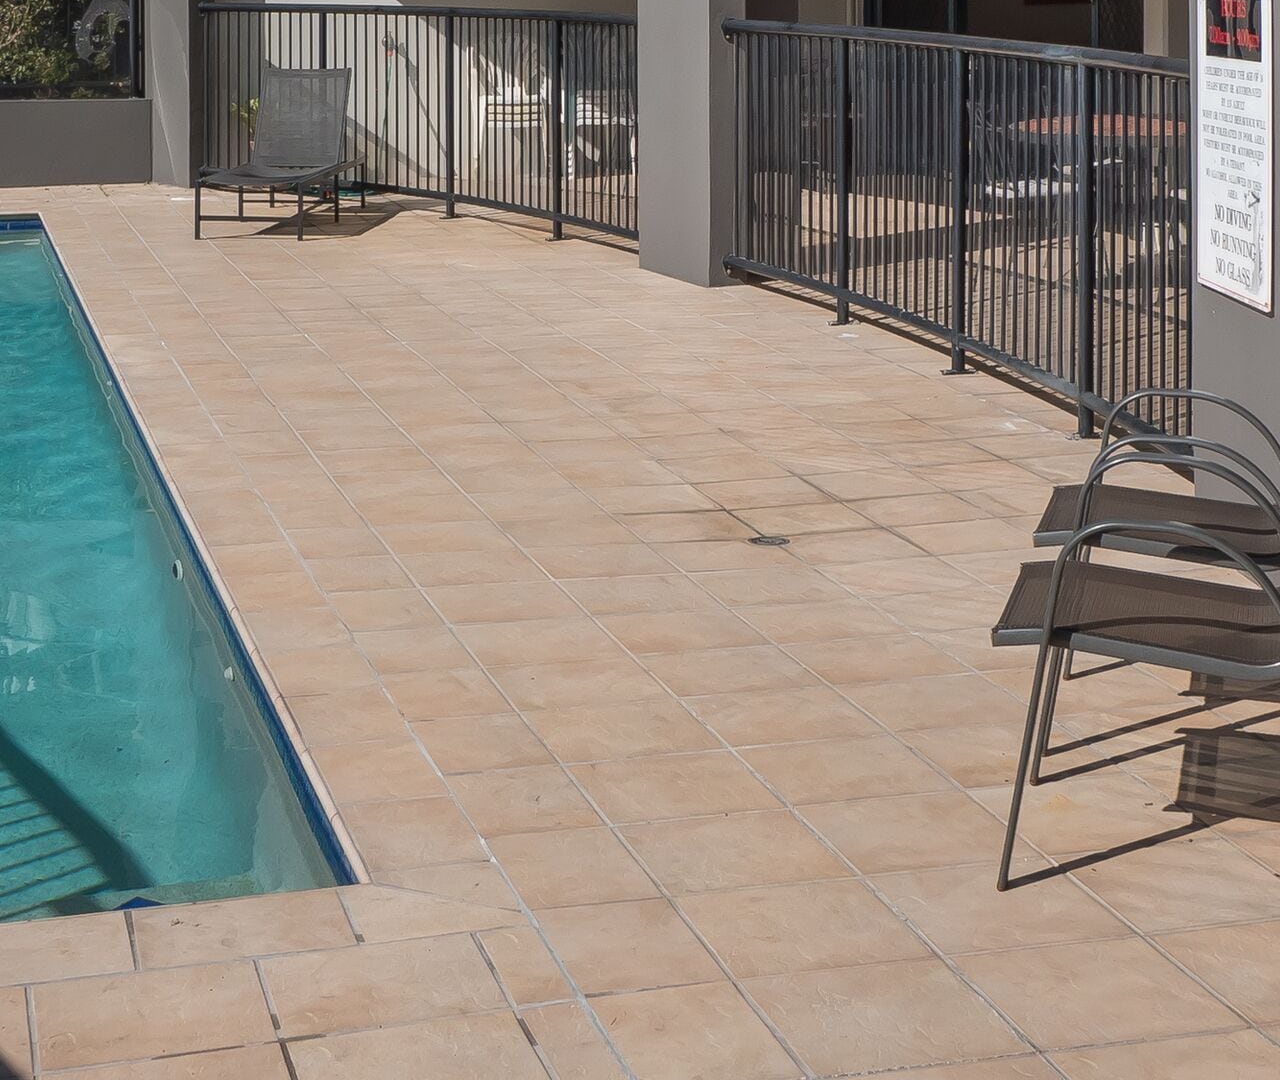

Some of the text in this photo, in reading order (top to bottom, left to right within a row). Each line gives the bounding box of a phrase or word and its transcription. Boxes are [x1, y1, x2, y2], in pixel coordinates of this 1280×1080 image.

[1214, 204, 1252, 232] NO DIVING
[1210, 229, 1257, 261] NO RUNNING
[1216, 256, 1251, 288] NO GLASS
